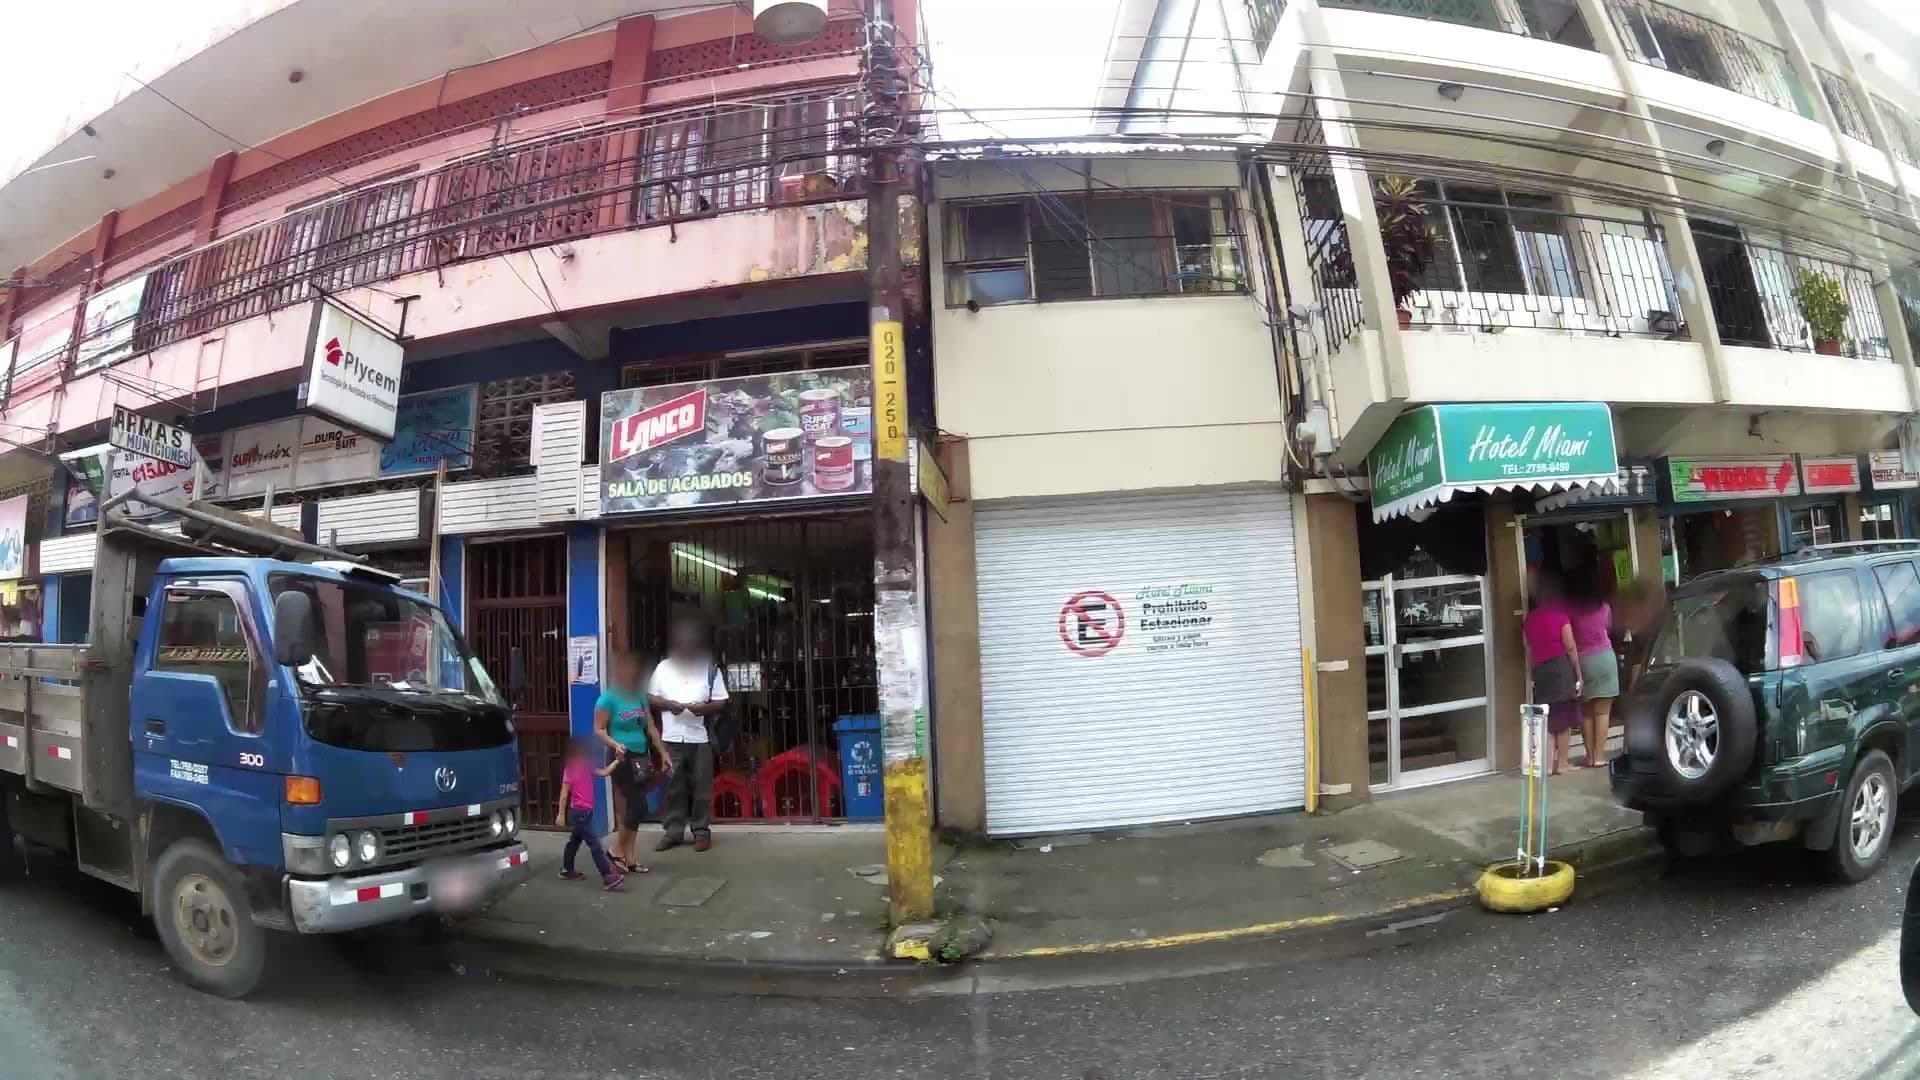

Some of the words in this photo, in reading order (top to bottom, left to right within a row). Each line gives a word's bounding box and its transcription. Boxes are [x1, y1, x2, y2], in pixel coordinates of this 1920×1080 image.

[344, 351, 396, 393] Plycem
[883, 331, 898, 439] 020-250
[114, 409, 183, 448] ARMAS
[620, 403, 696, 456] LANCO
[1470, 425, 1535, 462] Hotel
[1533, 424, 1593, 460] Miami
[127, 432, 189, 466] MUNICIONES
[1375, 443, 1403, 488] Hotel
[1403, 432, 1435, 478] Miami
[608, 480, 645, 498] SALA
[649, 476, 667, 496] DE
[671, 471, 752, 493] ACABADOS
[1140, 616, 1212, 631] Estacionar
[1143, 599, 1207, 615] Prohibido
[240, 753, 264, 767] 300
